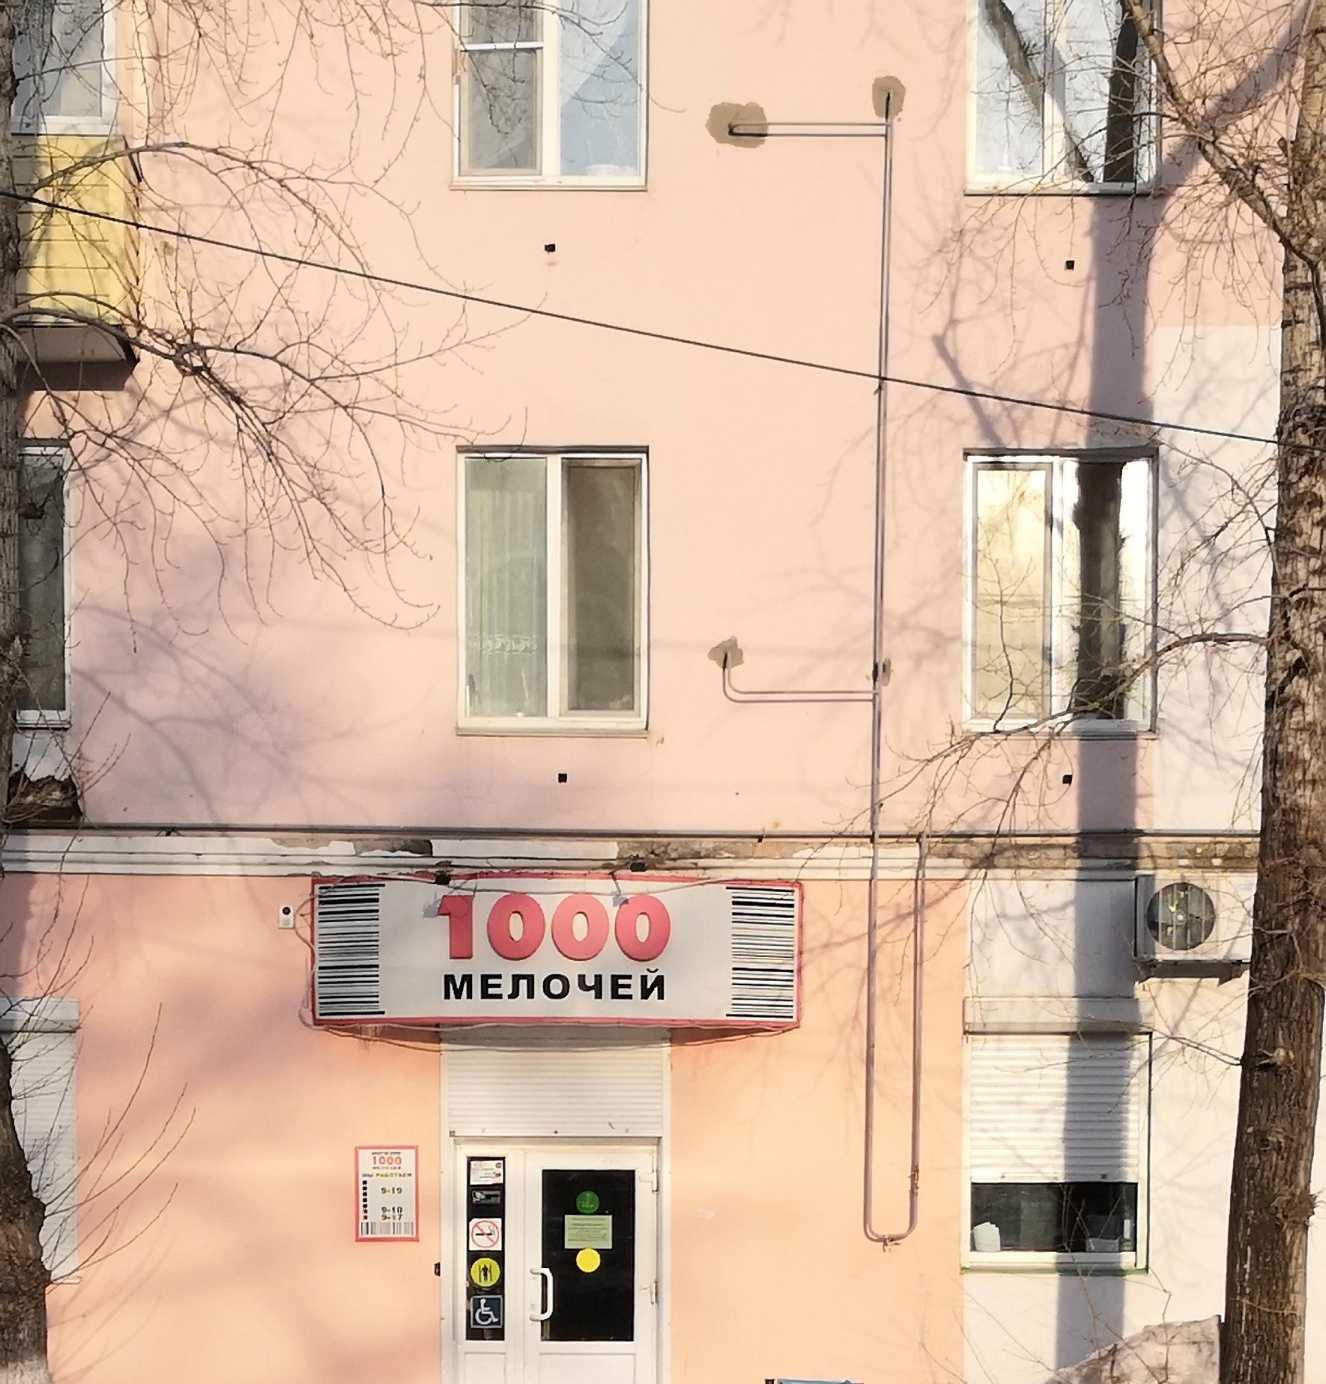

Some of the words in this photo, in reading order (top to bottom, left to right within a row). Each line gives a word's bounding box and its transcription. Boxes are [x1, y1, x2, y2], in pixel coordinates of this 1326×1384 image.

[438, 892, 672, 962] 1000
[443, 968, 666, 1001] МЕЛОЧЕЙ
[372, 1156, 402, 1166] 1000
